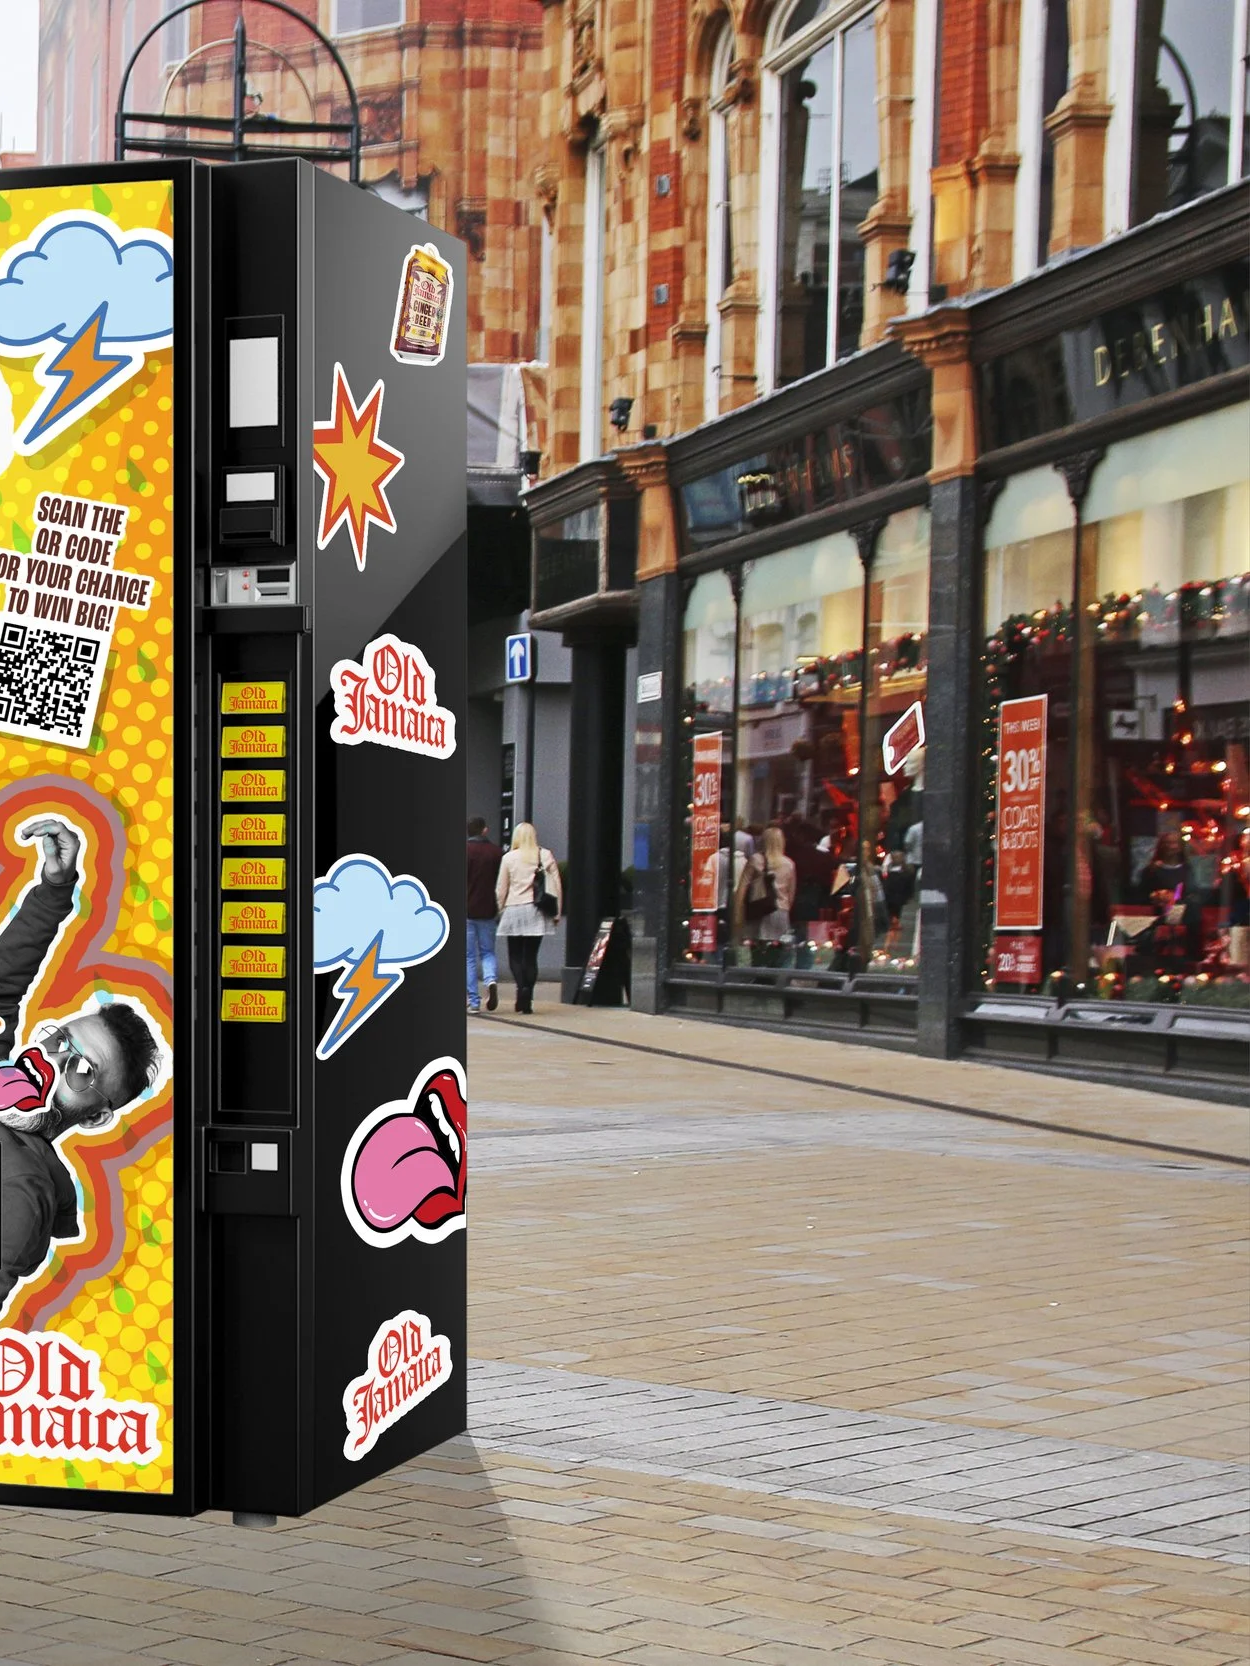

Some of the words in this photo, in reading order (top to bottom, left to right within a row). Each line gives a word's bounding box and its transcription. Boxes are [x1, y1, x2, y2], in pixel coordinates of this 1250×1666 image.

[421, 280, 436, 294] Old
[413, 300, 437, 317] GINGER
[414, 315, 432, 328] BEER
[37, 496, 89, 529] SCAN
[90, 505, 125, 536] THE
[36, 528, 62, 557] QR
[65, 534, 114, 567] CODE
[25, 558, 73, 591] YOUR
[75, 568, 150, 606] CHANCE
[8, 587, 30, 615] TO
[33, 592, 74, 624] WIN
[74, 600, 114, 632] BIG!
[372, 644, 427, 706] Old
[241, 687, 266, 699] Old
[229, 696, 278, 711] Jamaica
[340, 670, 446, 749] Jamaica
[1003, 721, 1020, 734] THIS
[241, 730, 266, 742] Old
[229, 740, 278, 755] Jamaica
[1002, 748, 1041, 793] 30%
[241, 773, 266, 786] Old
[229, 783, 278, 798] Jamaica
[241, 817, 266, 830] Old
[1002, 804, 1039, 830] COATS
[229, 827, 278, 843] Jamaica
[241, 862, 266, 874] Old
[229, 872, 278, 886] Jamaica
[241, 906, 266, 919] Old
[229, 916, 278, 931] Jamaica
[241, 949, 266, 962] Old
[229, 959, 278, 975] Jamaica
[241, 993, 266, 1006] Old
[229, 1003, 278, 1018] Jamaica
[378, 1320, 423, 1378] Old
[353, 1345, 442, 1451] Jamaica
